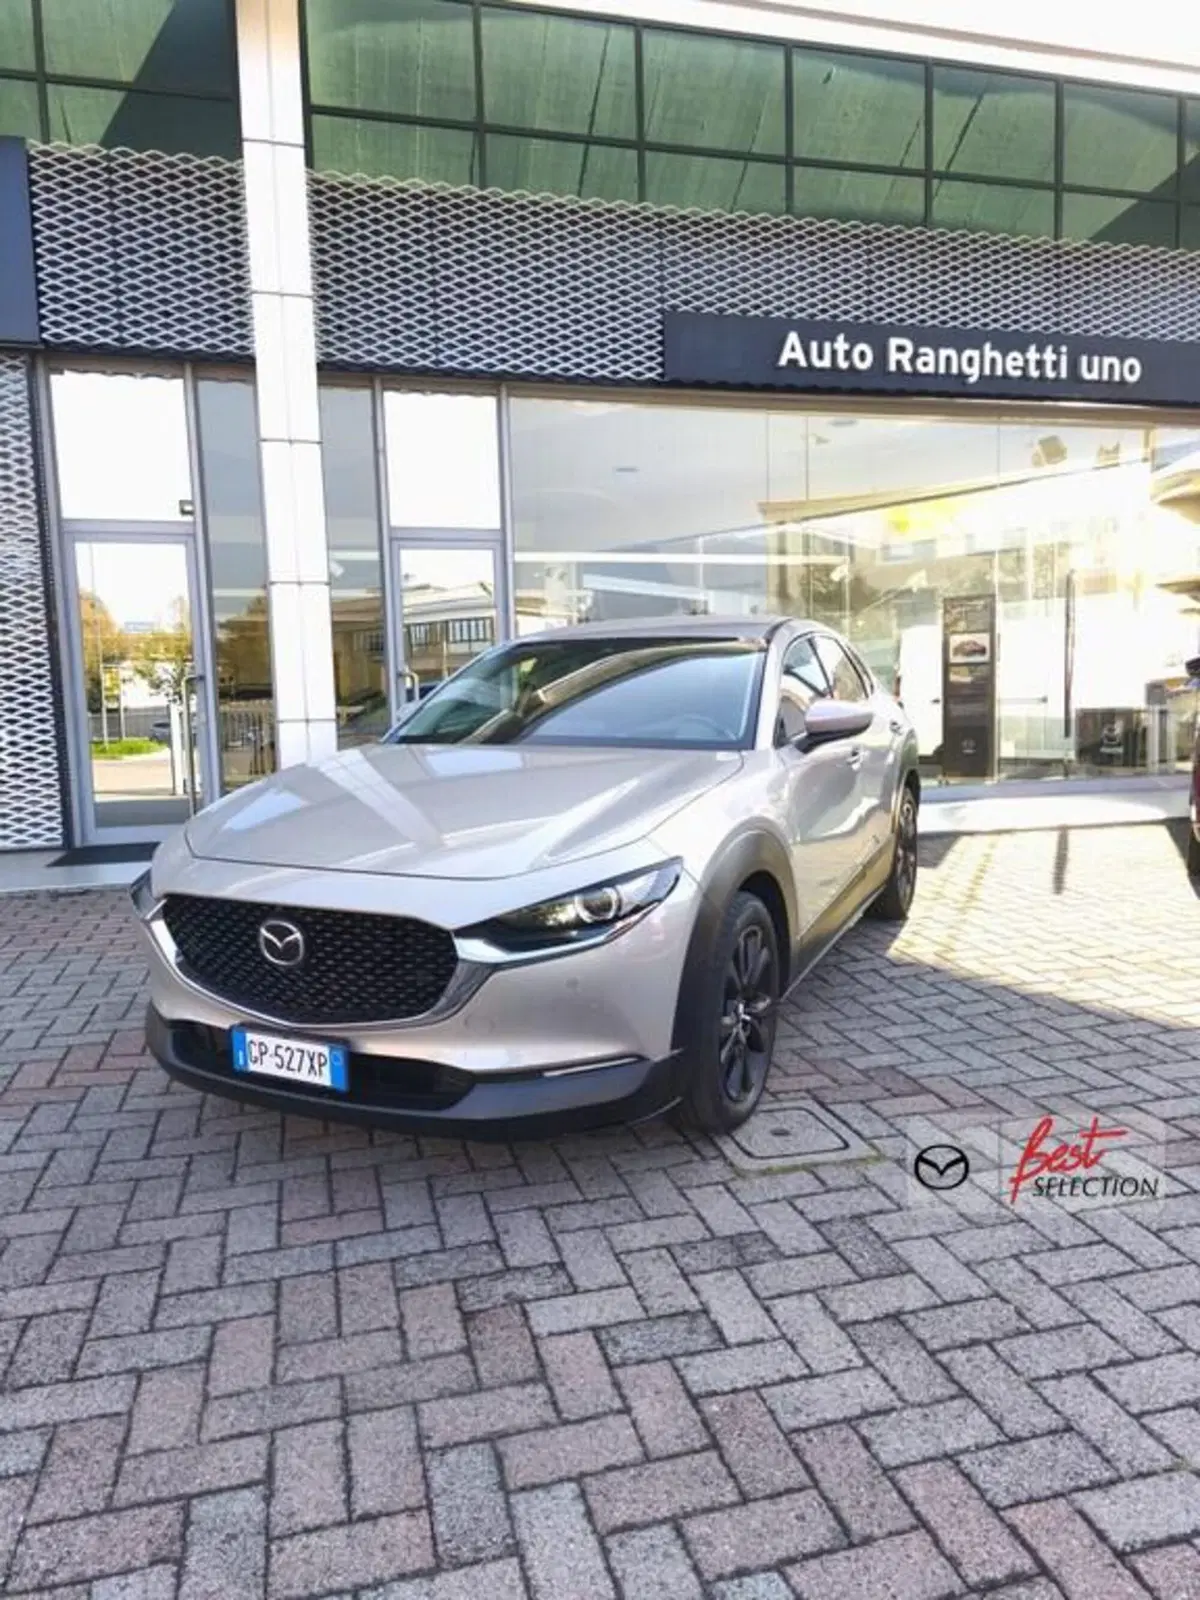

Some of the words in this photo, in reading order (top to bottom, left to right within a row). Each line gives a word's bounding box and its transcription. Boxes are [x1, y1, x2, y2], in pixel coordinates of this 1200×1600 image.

[778, 331, 874, 370] Auto
[888, 338, 1067, 384] Ranghetti
[1080, 352, 1142, 384] uno
